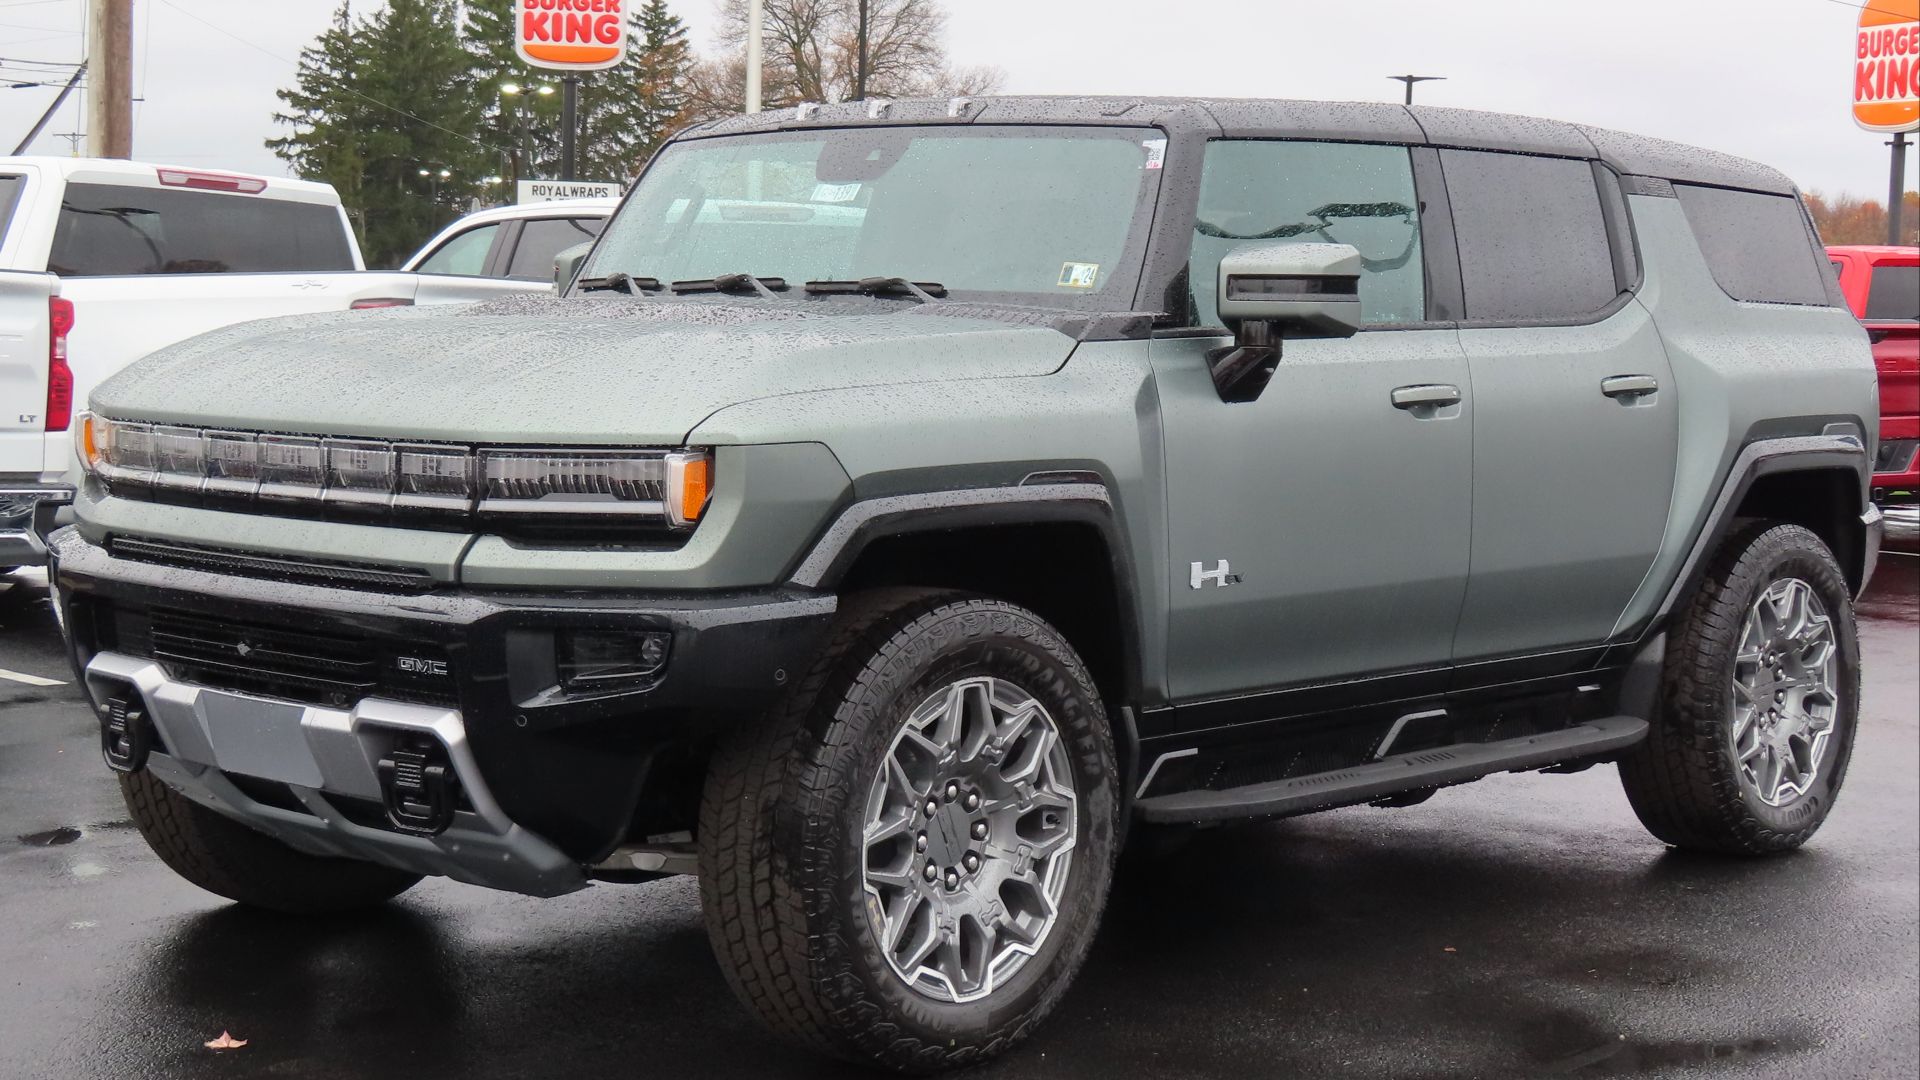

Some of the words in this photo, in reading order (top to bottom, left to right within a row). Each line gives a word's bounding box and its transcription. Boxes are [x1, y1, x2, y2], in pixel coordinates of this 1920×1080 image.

[523, 11, 620, 44] KING
[1857, 26, 1919, 59] BURGE
[19, 415, 37, 423] LT
[398, 656, 448, 675] GMC
